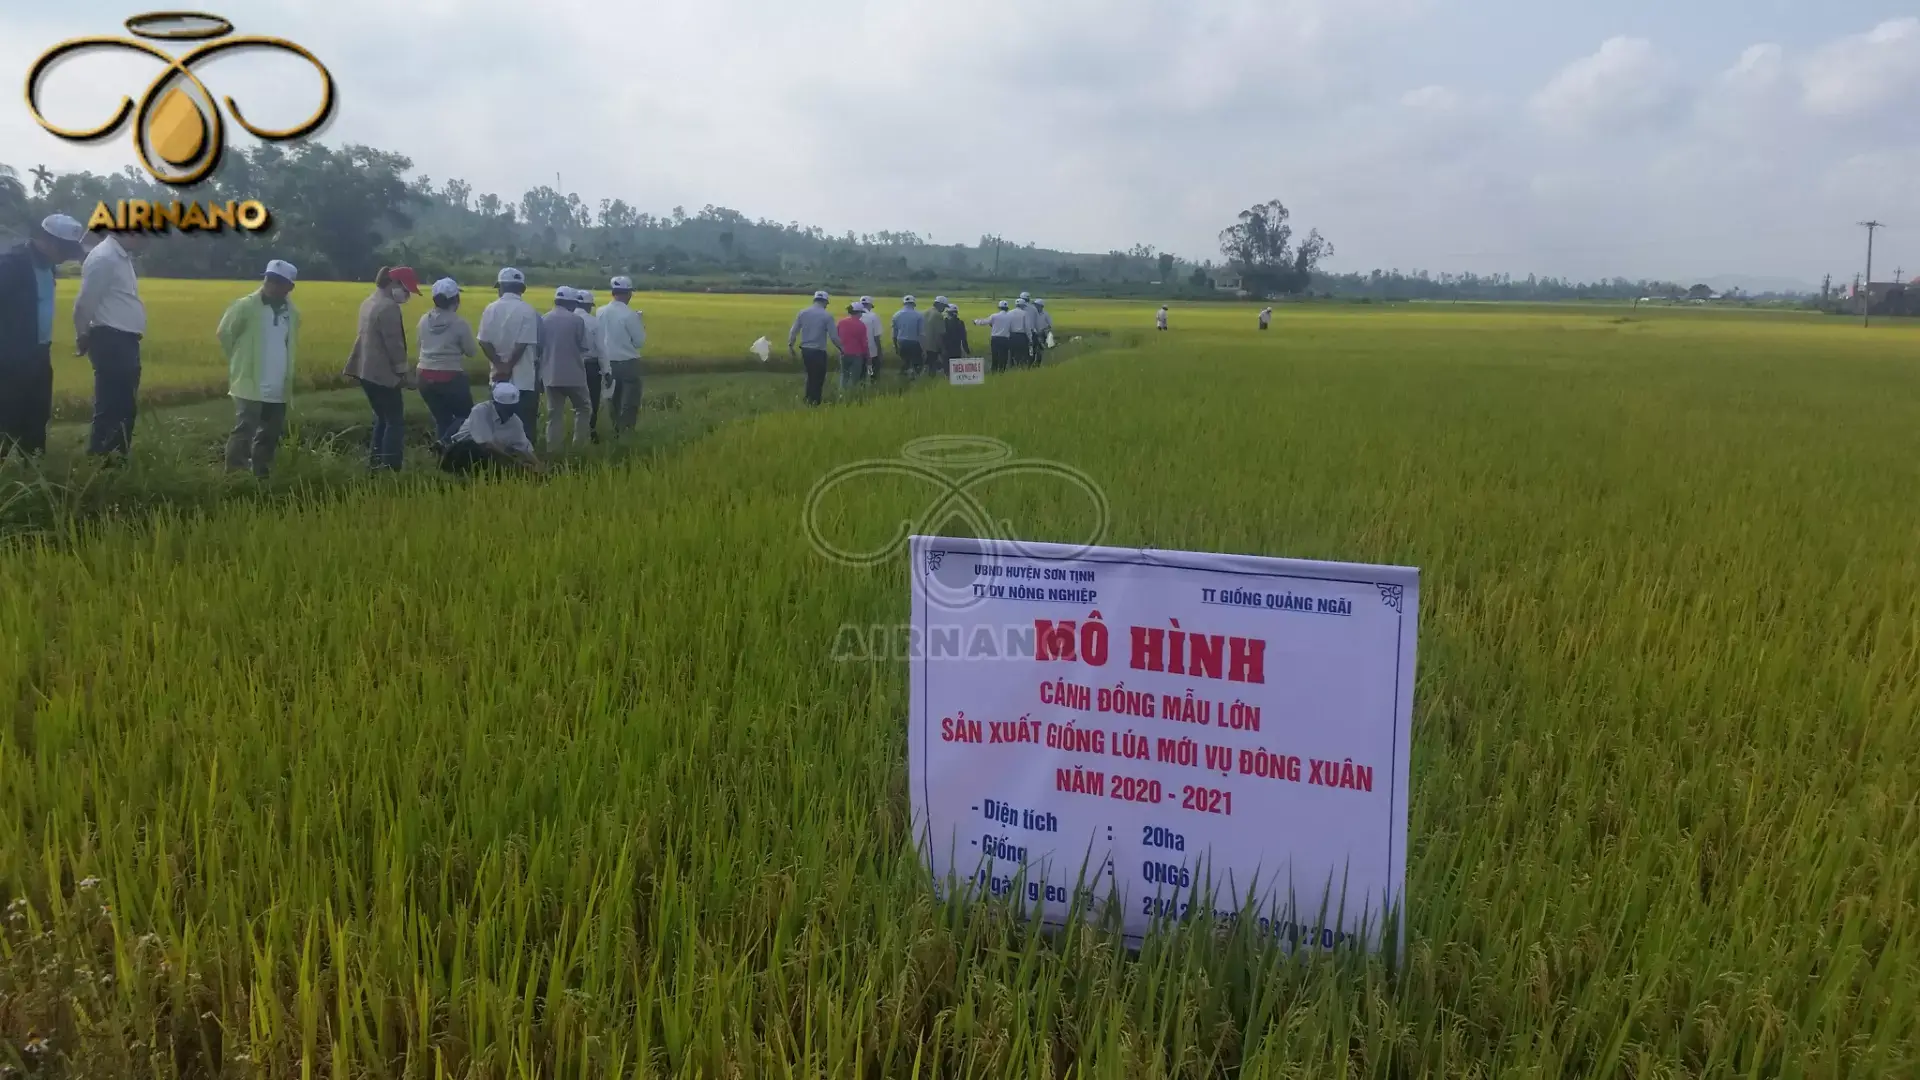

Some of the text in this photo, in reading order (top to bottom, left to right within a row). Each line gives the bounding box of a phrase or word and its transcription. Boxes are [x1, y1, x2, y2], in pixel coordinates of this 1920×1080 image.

[972, 583, 1097, 605] TT DV NÔNG NGHIỆP
[974, 563, 1095, 584] UBND HUYỆN SƠN TỊNH
[1201, 586, 1352, 615] TT GIỐNG QUẢNG NGÃI
[1034, 609, 1266, 684] MÔ HÌNH
[1039, 676, 1261, 732] CÁNH ĐỒNG MẪU LỚN
[941, 710, 1373, 792] SẢN XUẤT GIỐNG LÚA MỚI VỤ ĐÔNG XUÂN
[1056, 764, 1104, 796] NĂM
[1110, 775, 1162, 803] 2020
[1182, 785, 1232, 815] 2021
[983, 798, 1018, 828] Diện
[1022, 808, 1058, 832] tích
[1142, 825, 1185, 852] 20ha
[1143, 860, 1190, 888] QNG6
